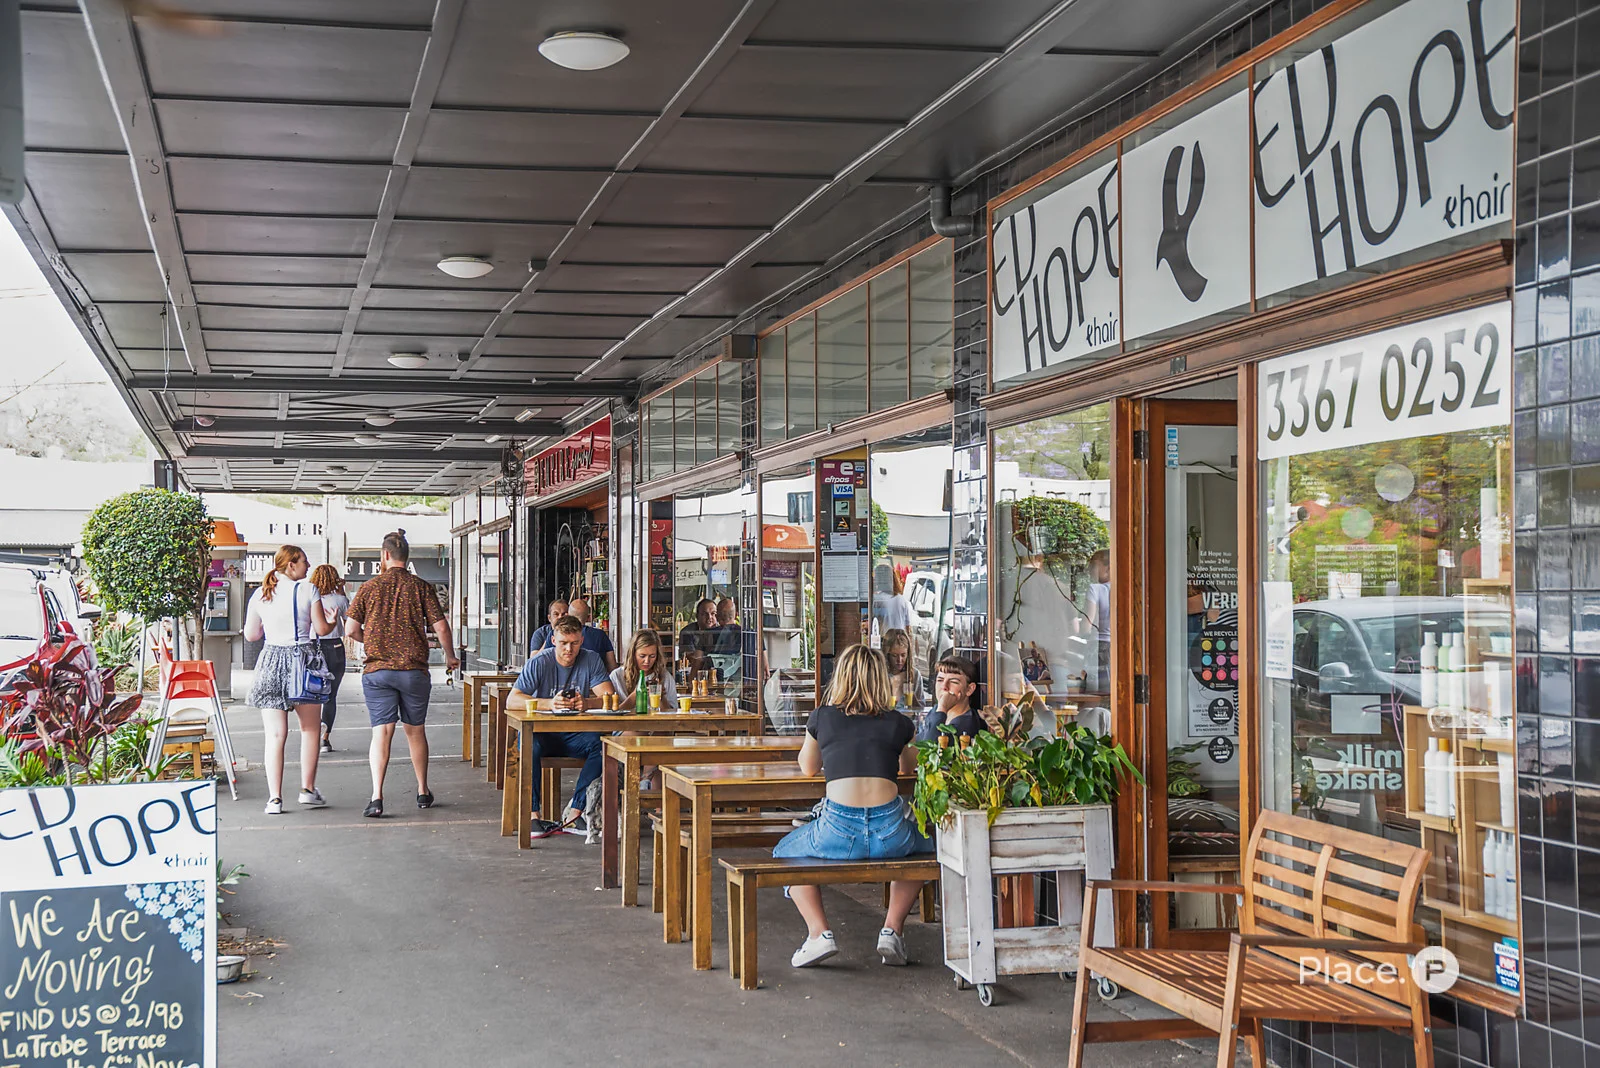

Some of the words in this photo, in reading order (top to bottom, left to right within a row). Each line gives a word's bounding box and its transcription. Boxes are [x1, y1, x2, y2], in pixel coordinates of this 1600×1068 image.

[1304, 0, 1516, 280] HOPE
[1019, 162, 1120, 373] HOPE
[1267, 351, 1363, 442] 3367
[1379, 322, 1501, 421] 0252
[824, 475, 850, 483] eftpos
[835, 485, 853, 493] VISA
[345, 561, 418, 575] FIEA
[1202, 592, 1238, 609] VERB
[43, 783, 217, 877] HOPE
[9, 895, 64, 950] We
[76, 898, 147, 943] Are
[5, 945, 155, 1006] Moving!
[0, 1008, 55, 1032] FIND
[61, 1004, 92, 1030] US
[96, 1004, 121, 1025] @
[125, 1000, 184, 1030] 2/98
[94, 1029, 168, 1054] Terrace
